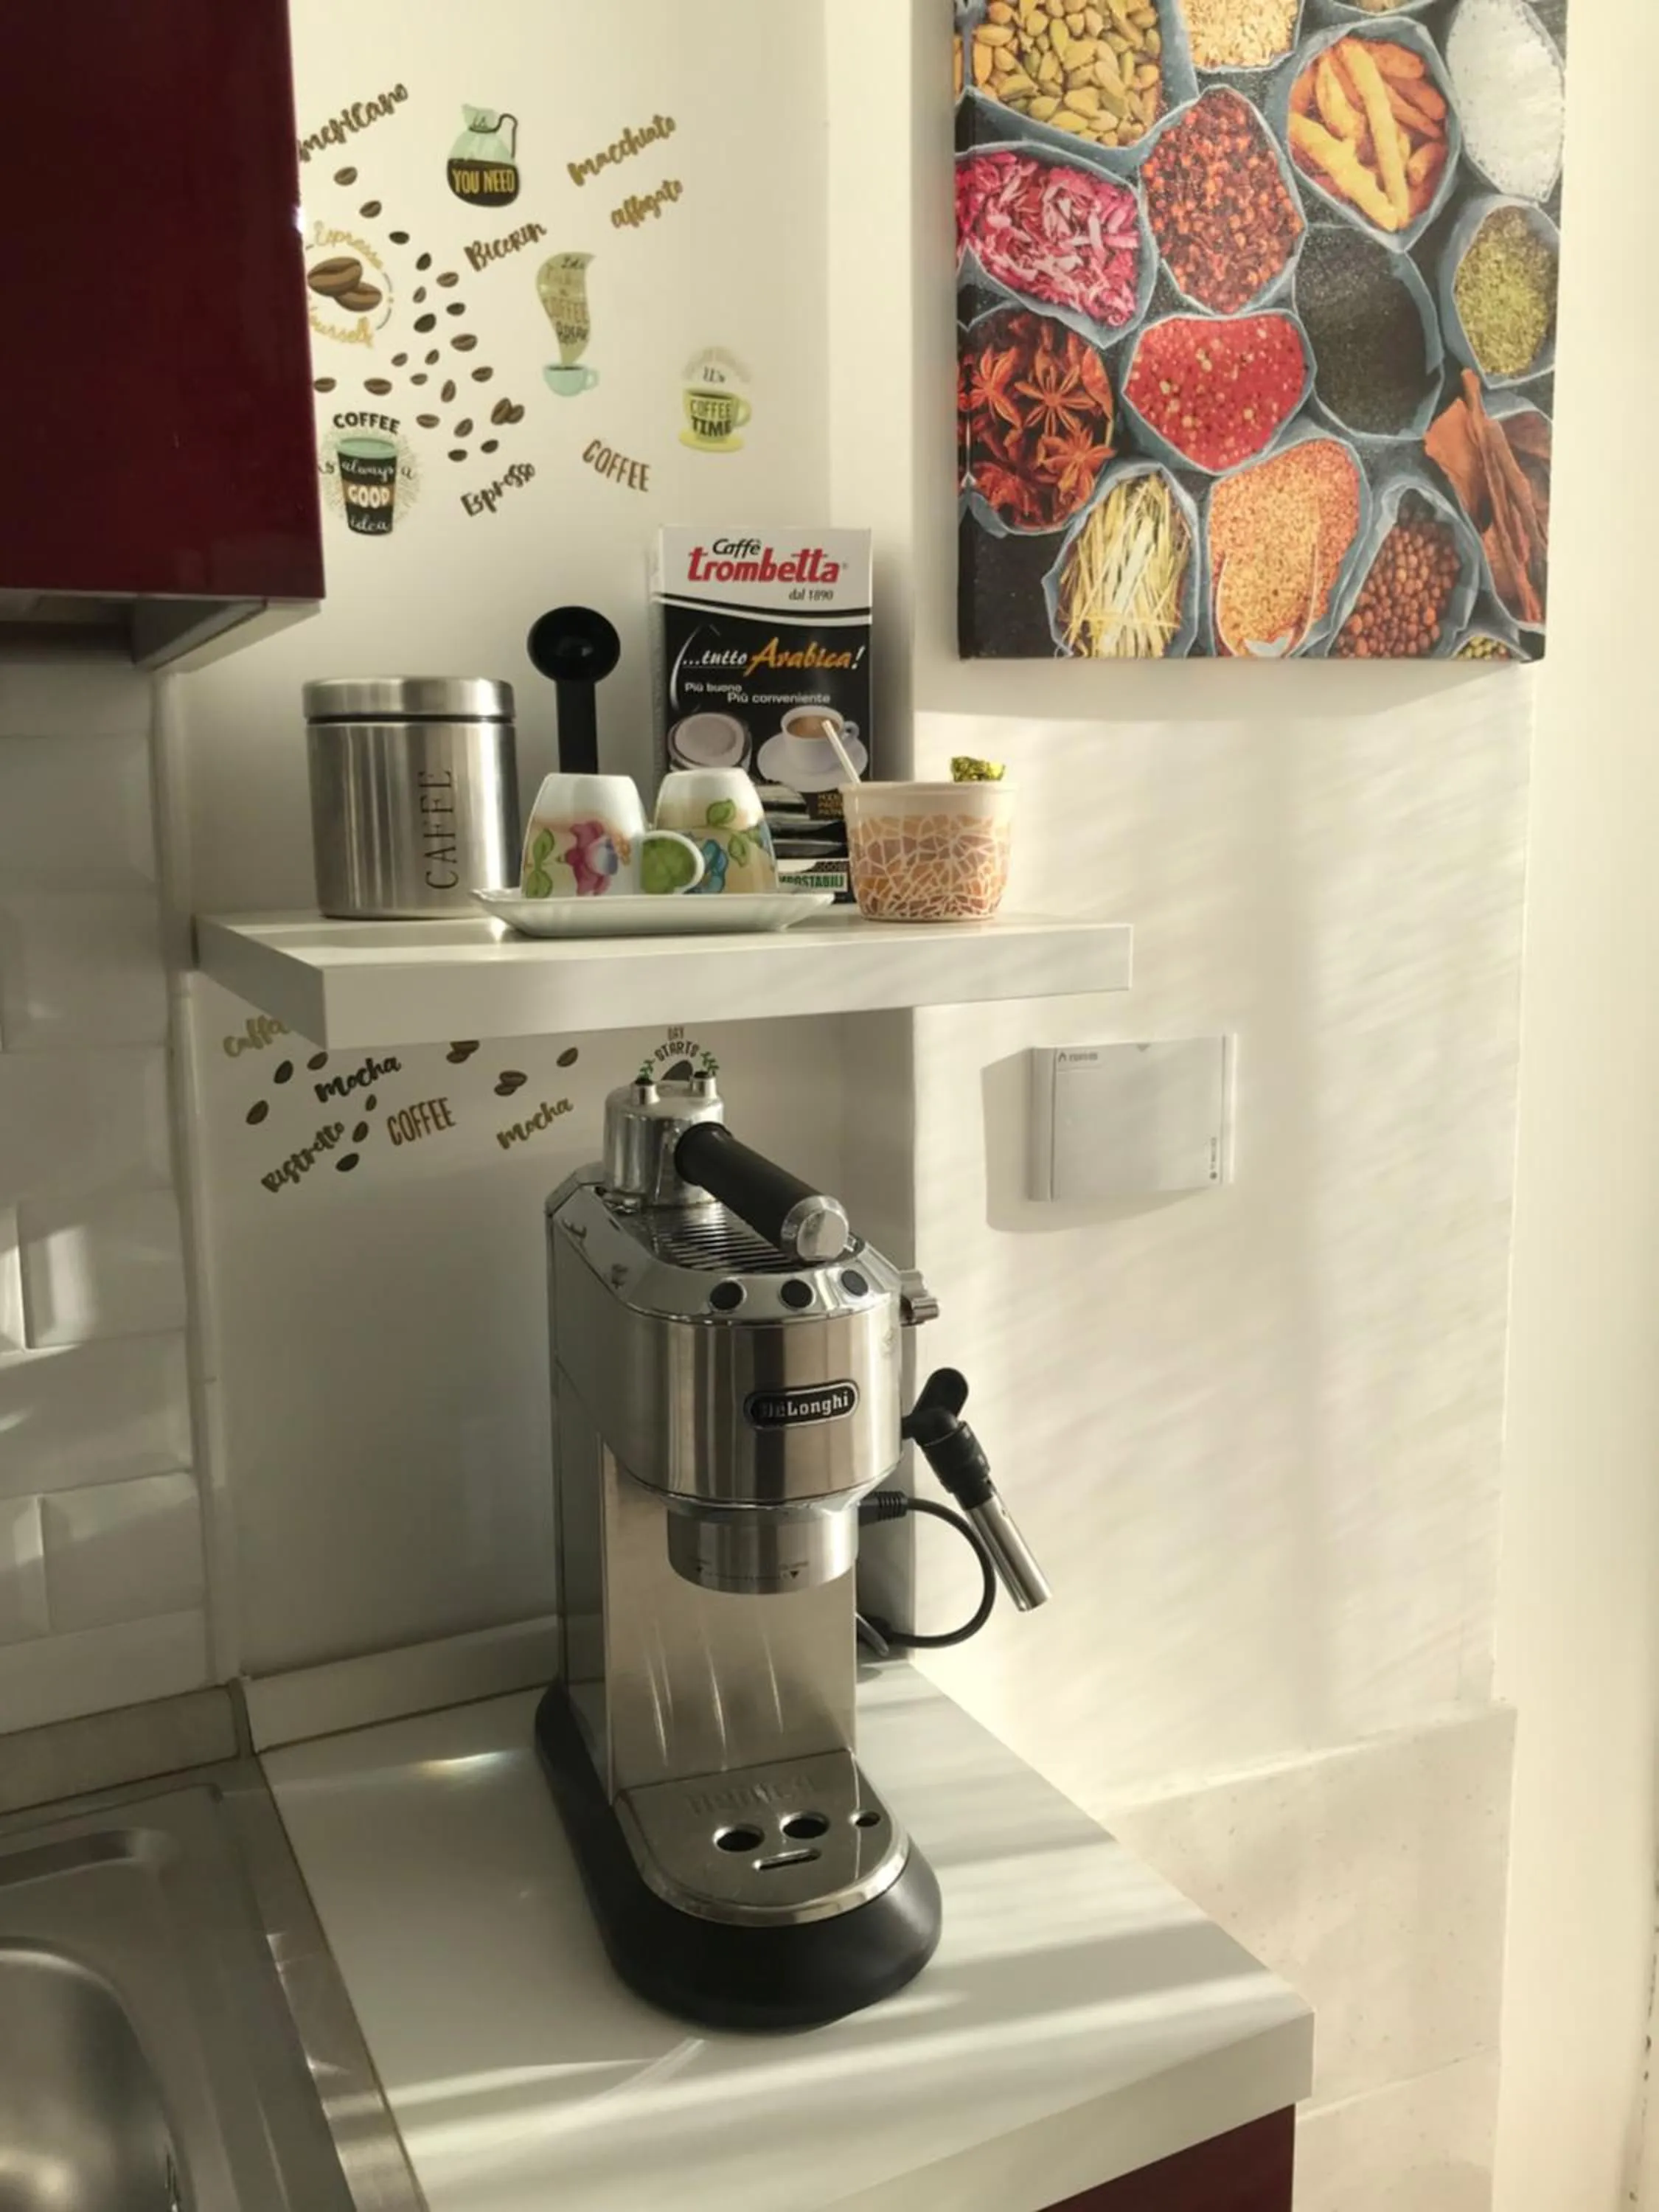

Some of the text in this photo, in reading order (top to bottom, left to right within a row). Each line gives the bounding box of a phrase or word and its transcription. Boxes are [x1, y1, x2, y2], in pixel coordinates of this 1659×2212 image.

[296, 83, 408, 163] mericano
[452, 167, 515, 194] YOU NEED
[690, 399, 731, 419] COFFEE
[333, 411, 400, 435] COFFEE
[692, 415, 732, 437] TIME
[341, 459, 394, 481] always
[582, 439, 650, 493] COFFEE
[348, 485, 390, 509] GOOD
[460, 462, 536, 517] Espresso
[712, 538, 761, 558] Caffè
[687, 547, 841, 583] trombetta
[789, 589, 834, 601] dal 1890
[743, 636, 866, 677] Arabica!
[684, 681, 742, 693] Più buono
[727, 691, 831, 704] Più conveniente
[314, 1056, 402, 1103] mocha
[386, 1096, 456, 1147] COFFEE
[495, 1097, 574, 1150] mocha
